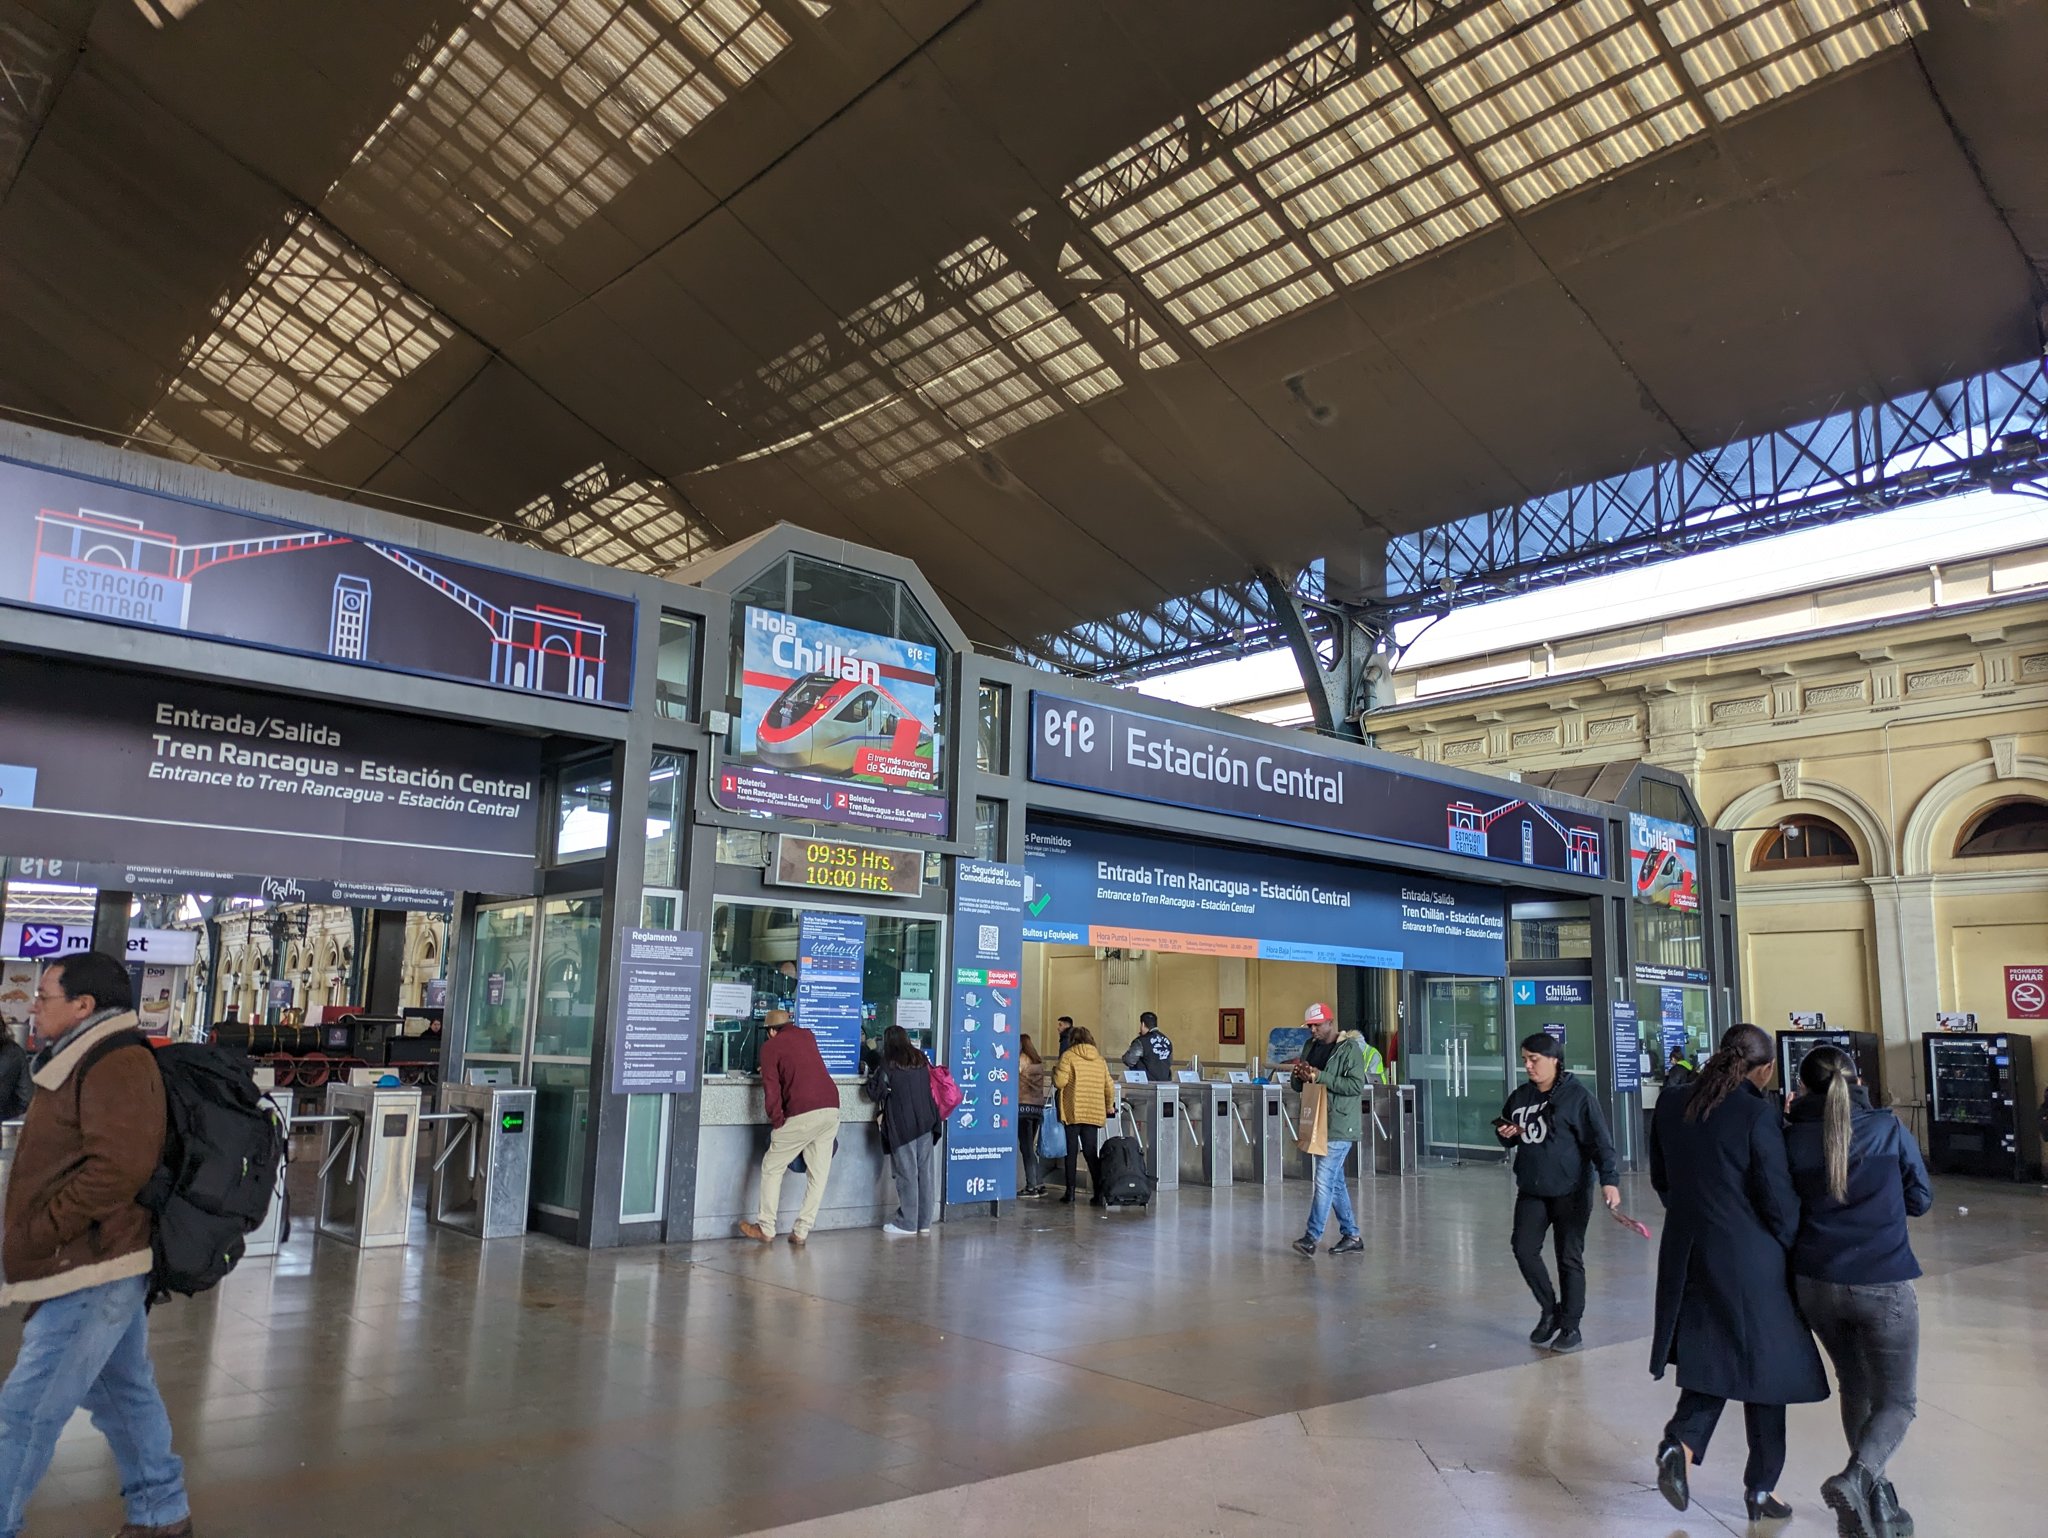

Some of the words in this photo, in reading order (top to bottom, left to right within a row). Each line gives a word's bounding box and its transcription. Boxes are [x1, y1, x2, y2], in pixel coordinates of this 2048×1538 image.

[62, 566, 163, 601] ESTACIÓN
[64, 589, 157, 622] CENTRAL
[752, 608, 797, 637] Hola
[772, 635, 880, 686] Chillán
[907, 648, 923, 661] efe
[156, 703, 341, 746] Entrada/Salida
[1044, 709, 1094, 758] efe
[153, 734, 212, 762] Tren
[219, 742, 339, 777] Rancagua
[360, 760, 453, 790] Estación
[459, 774, 531, 800] Central
[868, 753, 873, 761] El
[874, 755, 887, 763] tren
[888, 757, 901, 765] más
[901, 759, 928, 770] moderno
[1127, 727, 1249, 787] Estación
[1256, 756, 1343, 805] Central
[867, 763, 877, 772] de
[879, 763, 931, 781] Sudamérica
[148, 762, 232, 785] Entrance
[236, 773, 254, 788] to
[259, 773, 298, 793] Tren
[301, 779, 384, 803] Rancagua
[399, 790, 464, 812] Estación
[468, 799, 520, 818] Central
[726, 778, 733, 791] 1
[737, 777, 767, 789] Boletería
[737, 786, 752, 795] Tren
[753, 789, 783, 800] Rancagua
[788, 794, 799, 802] Est.
[800, 795, 821, 805] Central
[838, 795, 845, 806] 2
[849, 794, 875, 804] Boletería
[849, 803, 862, 811] Tren
[863, 804, 891, 815] Rancagua
[895, 809, 906, 817] Est.
[906, 810, 927, 819] Central
[1630, 813, 1646, 827] Hola
[1030, 833, 1071, 847] Permitidos
[1455, 831, 1480, 845] ESTACIÓN
[1639, 827, 1676, 852] Chillán
[1456, 842, 1480, 854] CENTRAL
[807, 844, 857, 867] 09:35
[861, 850, 895, 871] Hrs.
[173, 869, 200, 877] nuestro
[806, 866, 856, 888] 10:00
[860, 871, 893, 891] Hrs.
[960, 863, 971, 872] Por
[972, 864, 1004, 876] Seguridad
[1005, 871, 1009, 879] y
[960, 872, 995, 884] Comodidad
[1005, 878, 1021, 887] todos
[1097, 861, 1152, 885] Entrada
[1154, 868, 1185, 889] Tren
[1188, 872, 1250, 898] Rancagua
[1260, 881, 1310, 903] Estación
[1311, 887, 1351, 907] Central
[348, 883, 375, 891] nuestras
[394, 886, 419, 894] sociales
[419, 888, 445, 896] oficiales:
[1402, 888, 1455, 906] Entrada/Salida
[1097, 888, 1131, 901] Entrance
[1132, 892, 1140, 902] to
[1142, 892, 1158, 904] Tren
[1159, 895, 1195, 909] Rancagua
[1201, 899, 1230, 912] Estación
[1231, 902, 1255, 914] Central
[1402, 905, 1419, 918] Tren
[1421, 907, 1444, 920] Chillán
[1450, 911, 1479, 924] Estación
[1480, 914, 1503, 927] Central
[25, 926, 59, 948] XS
[632, 931, 678, 942] Reglamento
[1022, 928, 1042, 937] Bultos
[1043, 930, 1048, 939] y
[1049, 930, 1078, 940] Equipajes
[1097, 932, 1110, 940] Hora
[1111, 933, 1127, 941] Punta
[1402, 921, 1426, 932] Entrance
[1427, 924, 1433, 933] to
[1432, 924, 1444, 934] Tren
[1445, 926, 1461, 936] Chillán
[1466, 928, 1486, 938] Estación
[1487, 930, 1502, 940] Central
[1266, 946, 1278, 954] Hora
[1279, 947, 1289, 955] Baja
[147, 968, 165, 976] Dog
[958, 969, 978, 977] Equipaje
[988, 971, 1008, 980] Equipaje
[1545, 985, 1577, 995] Chillán
[967, 1177, 985, 1196] efe
